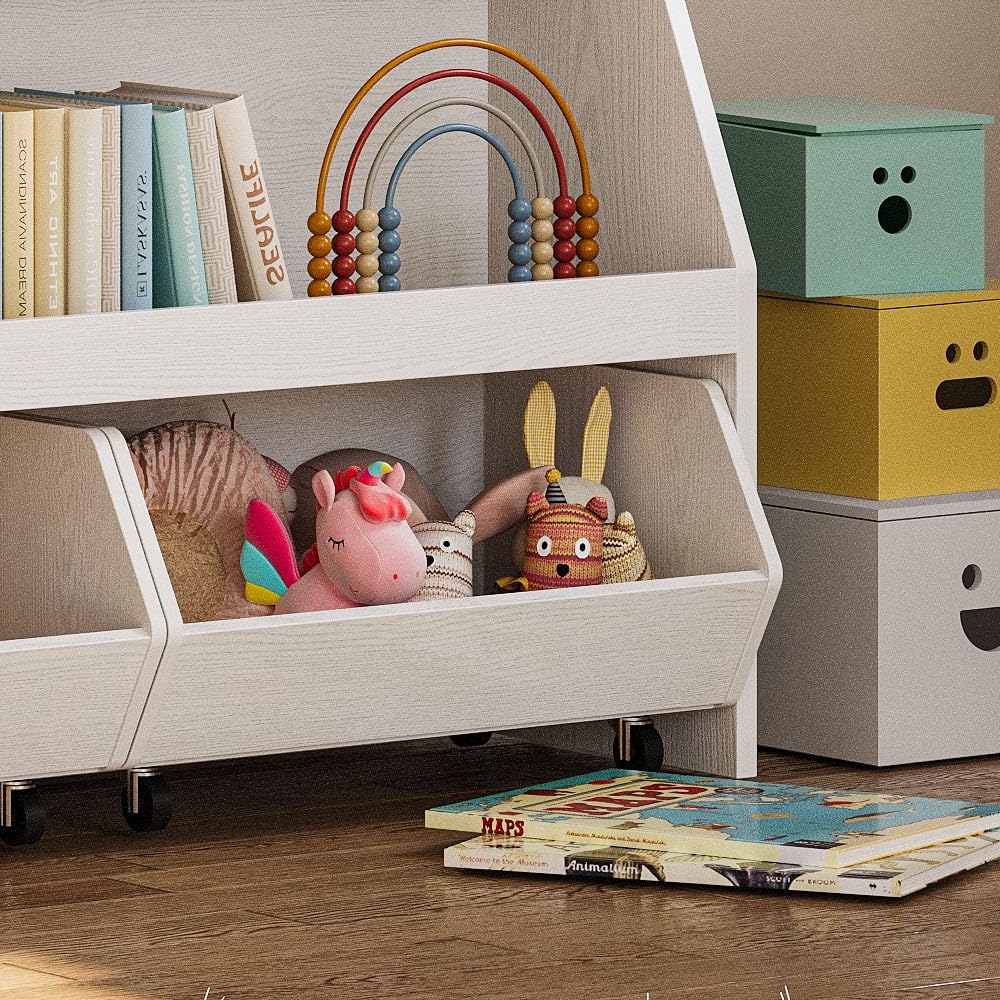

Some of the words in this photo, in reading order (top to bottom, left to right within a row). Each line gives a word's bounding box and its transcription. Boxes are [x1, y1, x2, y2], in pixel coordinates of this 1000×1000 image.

[545, 782, 710, 817] MAPS
[481, 816, 525, 838] MAPS
[564, 859, 641, 875] Animalium
